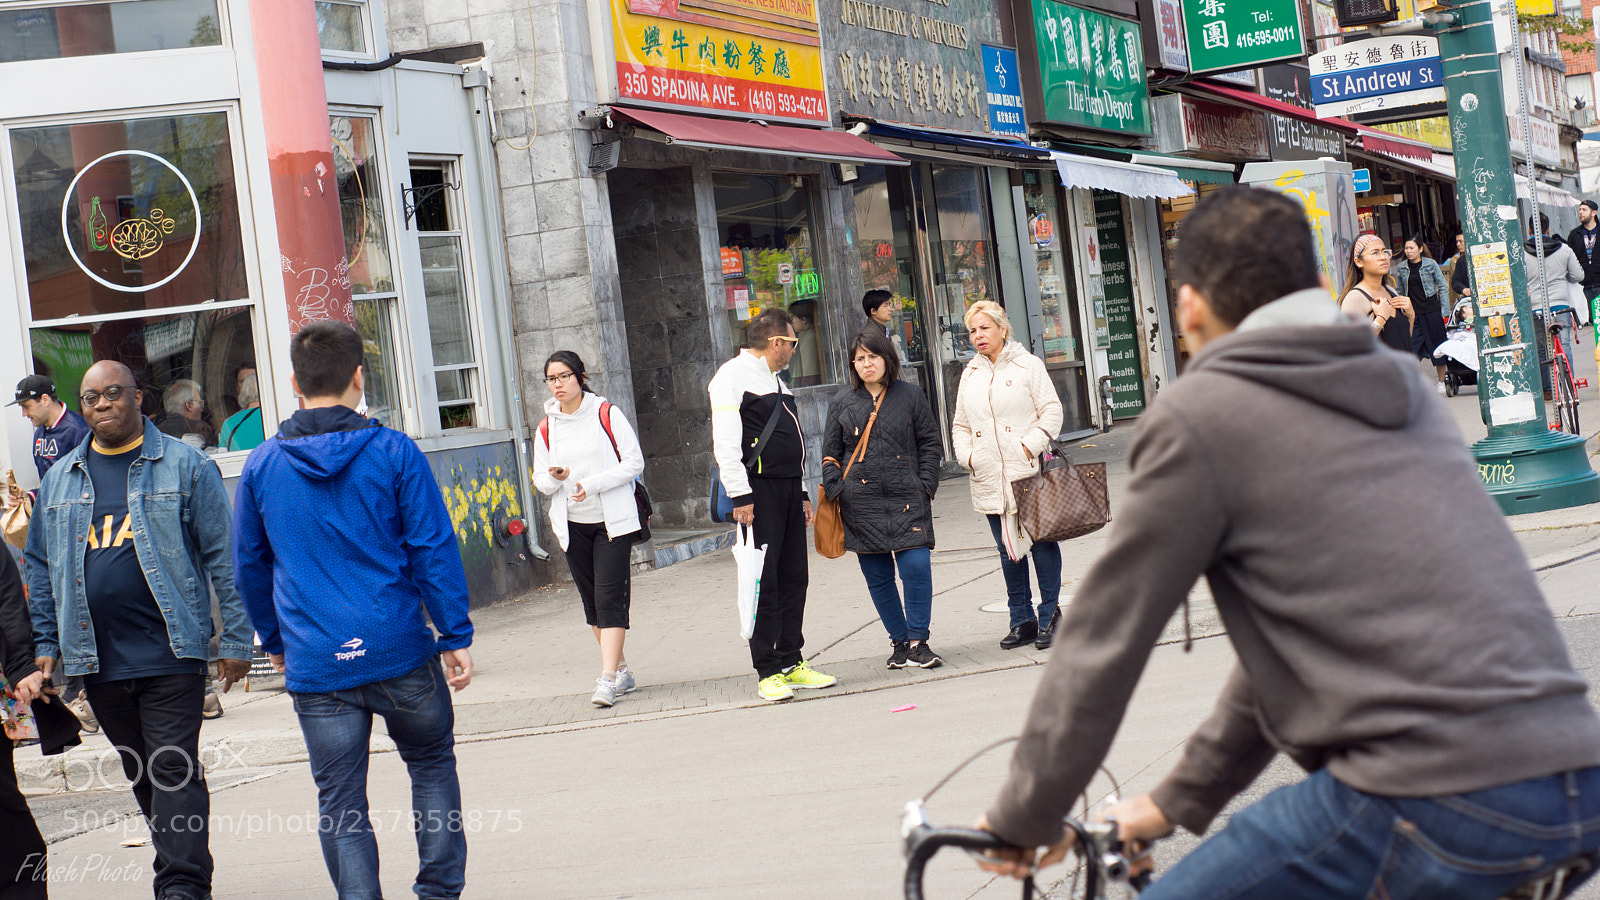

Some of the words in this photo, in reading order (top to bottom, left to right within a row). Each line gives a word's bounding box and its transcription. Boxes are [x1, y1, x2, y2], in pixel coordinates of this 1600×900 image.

[1251, 10, 1274, 24] Tel:
[841, 0, 907, 37] JEWELLERY
[911, 13, 920, 39] &
[920, 16, 967, 50] WATCHES
[1236, 25, 1296, 49] 416-595-0011
[641, 25, 791, 80] 興牛肉粉餐廳
[1321, 40, 1428, 72] 聖安德魯街
[1321, 76, 1341, 99] St
[1344, 70, 1412, 96] Andrew
[1419, 67, 1435, 84] St
[624, 72, 648, 96] 350
[652, 76, 710, 102] SPADINA
[712, 84, 740, 107] AVE.
[749, 88, 777, 115] (416)
[778, 93, 825, 117] 593-4274
[1065, 80, 1084, 112] The
[1083, 84, 1104, 117] Herb
[1102, 89, 1134, 129] Depot
[1377, 97, 1385, 108] 2
[876, 243, 893, 259] OPEN
[1101, 260, 1126, 273] hinese
[795, 271, 820, 298] OPEN
[1107, 306, 1120, 315] rbal
[1114, 313, 1128, 322] bag)
[1109, 332, 1133, 342] edicine
[1108, 350, 1123, 361] and
[1124, 348, 1135, 359] all
[1111, 366, 1136, 378] health
[1113, 381, 1139, 394] related
[1112, 398, 1143, 411] products
[34, 438, 58, 457] FILA
[335, 649, 367, 661] Topper
